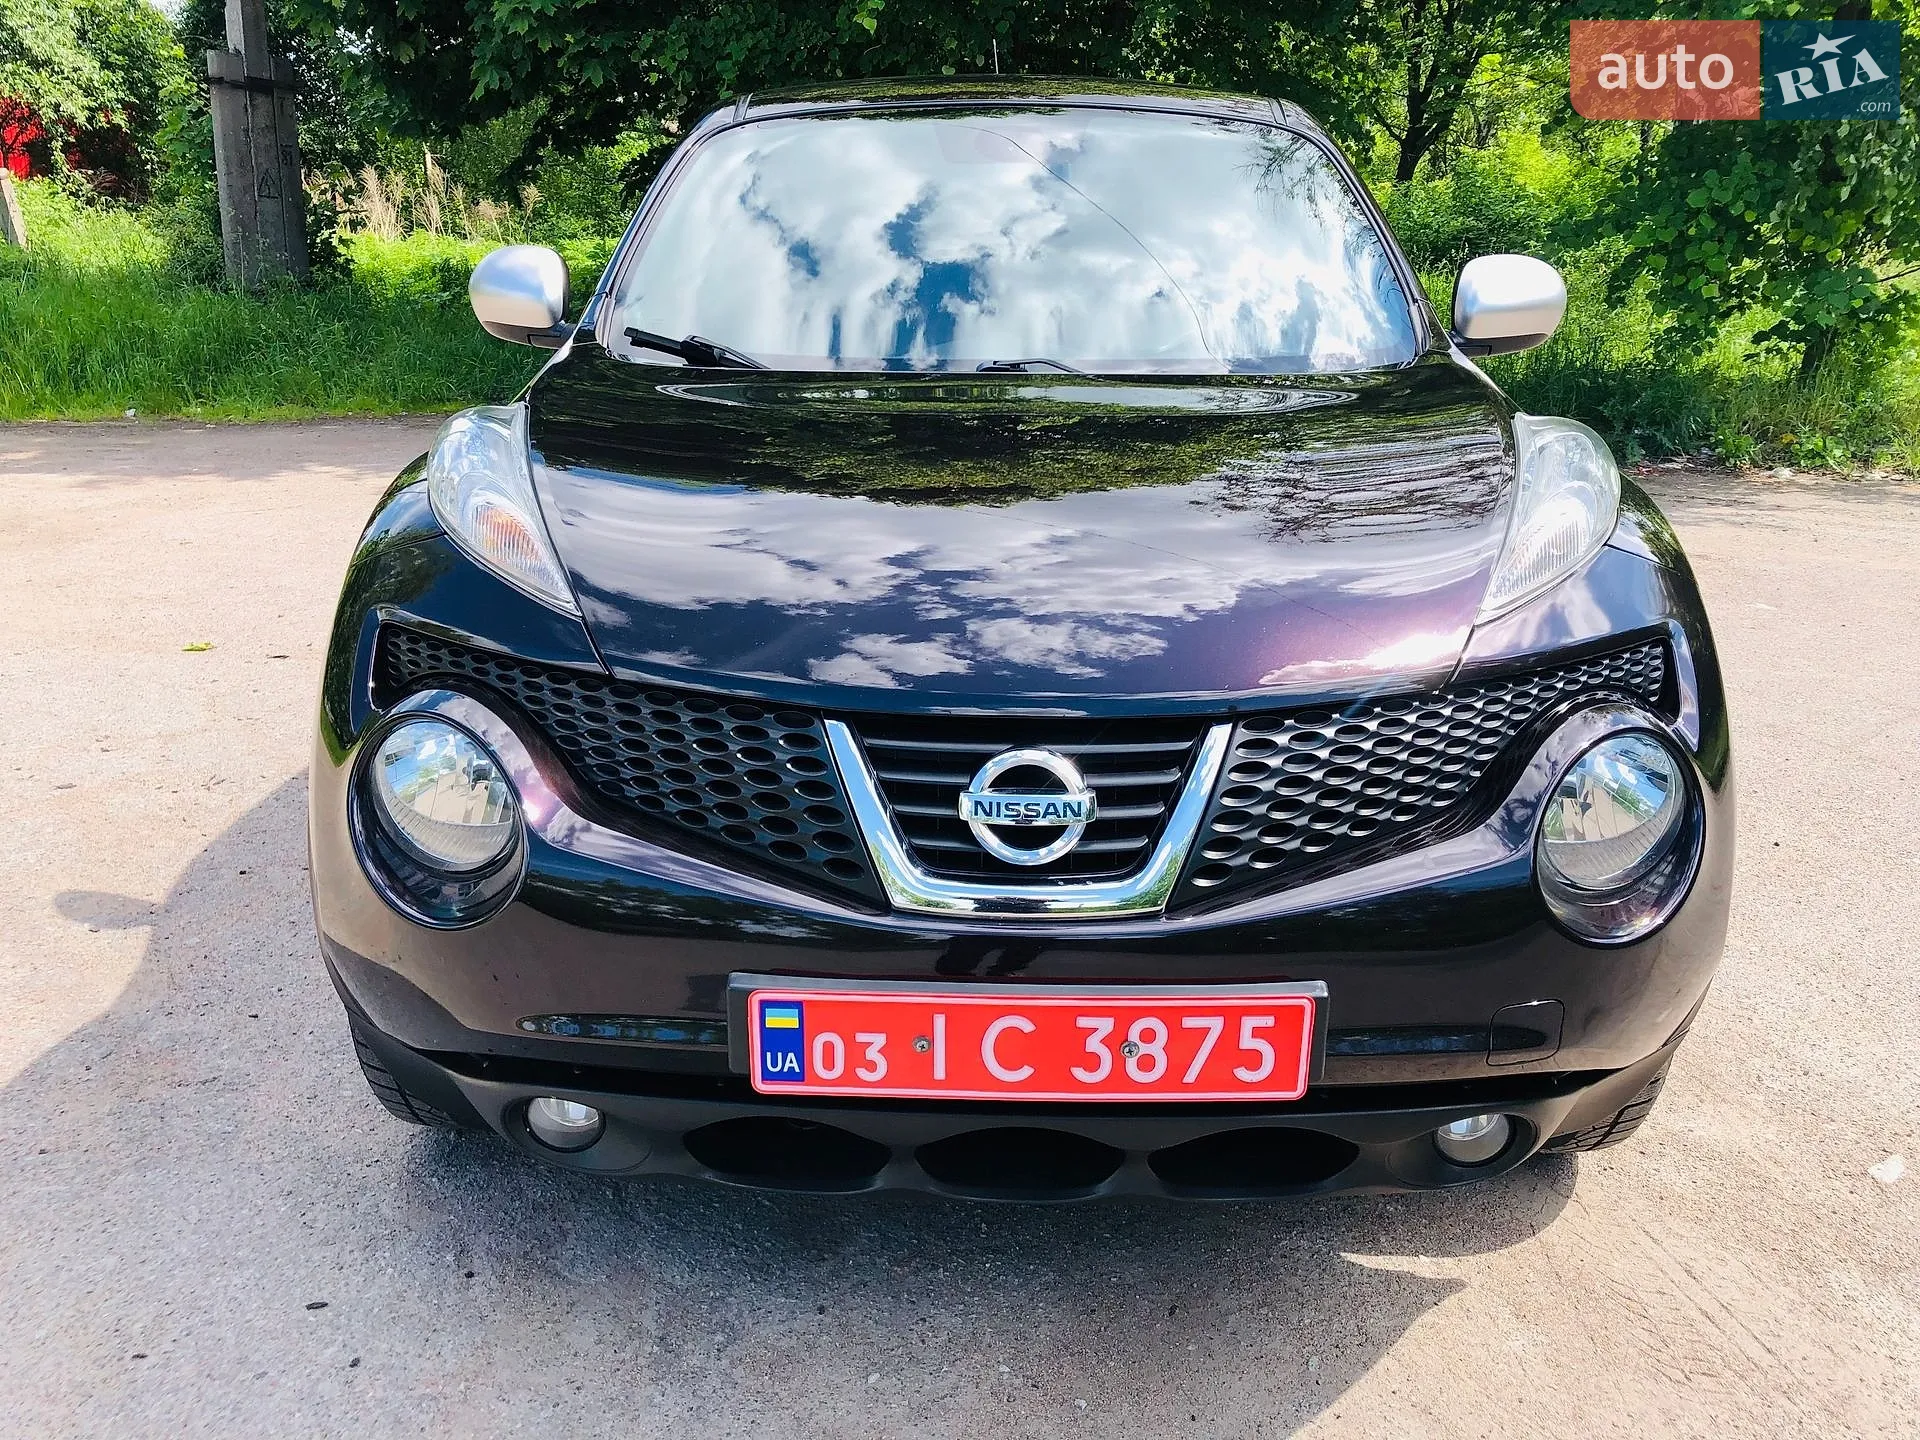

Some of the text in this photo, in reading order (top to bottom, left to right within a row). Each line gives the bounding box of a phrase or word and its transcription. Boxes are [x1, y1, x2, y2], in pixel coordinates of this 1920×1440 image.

[973, 800, 1082, 818] NISSAN
[812, 1031, 888, 1082] 03
[1069, 1015, 1276, 1084] 3875
[766, 1051, 800, 1072] UA
